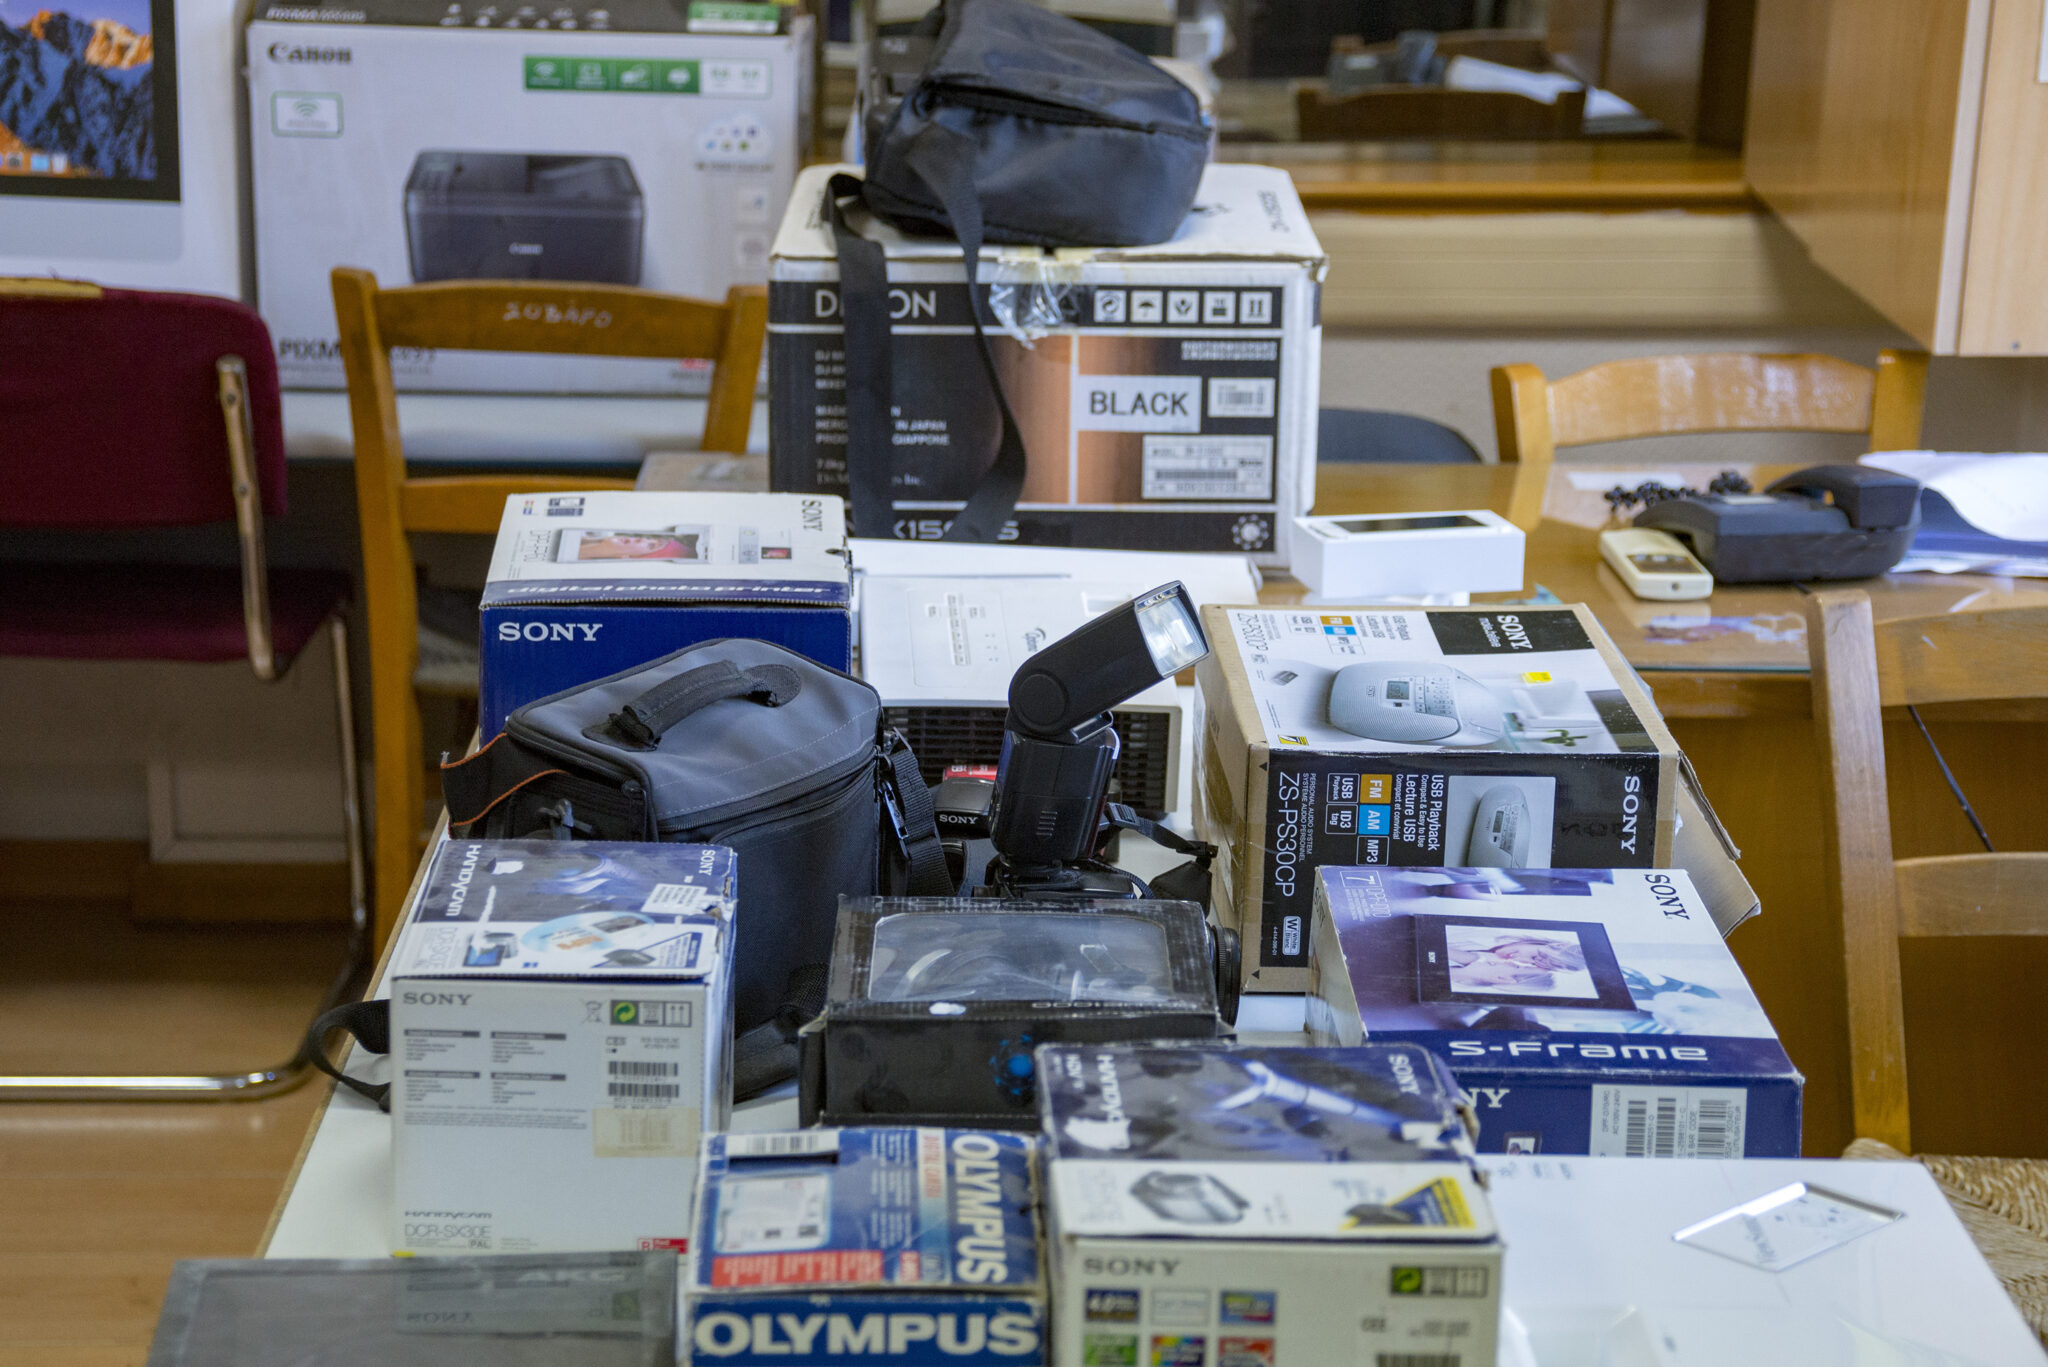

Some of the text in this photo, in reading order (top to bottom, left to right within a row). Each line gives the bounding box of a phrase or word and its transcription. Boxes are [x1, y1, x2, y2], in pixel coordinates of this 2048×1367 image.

[267, 41, 353, 64] Canon
[1089, 390, 1189, 417] BLACK
[801, 499, 823, 531] SONY
[507, 584, 831, 594] digital photo printer
[499, 622, 603, 642] SONY
[1497, 615, 1534, 650] SONY
[1333, 775, 1341, 801] Playback
[1342, 777, 1354, 799] USB
[1369, 779, 1383, 799] FM
[1393, 774, 1404, 803] Compact
[1419, 774, 1430, 803] Compact
[939, 813, 979, 825] SONY
[1300, 803, 1308, 824] AUDIO
[1306, 773, 1317, 855] PERSONAL AUDIO SYSTEM
[1329, 812, 1339, 826] tag
[1340, 810, 1352, 829] ID3
[1403, 774, 1419, 843] Lecture USB
[1417, 810, 1427, 827] Easy
[1427, 774, 1444, 851] USB Playback
[1621, 775, 1641, 855] SONY
[1367, 810, 1381, 830] AM
[1392, 811, 1401, 840] convivial
[1274, 771, 1301, 897] ZS-PS30CP
[1298, 824, 1307, 863] PERSONNEL
[1417, 835, 1425, 848] Use
[699, 849, 716, 876] SONY
[1366, 839, 1379, 864] MP3
[446, 844, 483, 917] HANDYCAM
[1644, 873, 1691, 921] SONY
[1285, 917, 1298, 931] W
[1283, 932, 1291, 950] Blanc
[1290, 932, 1299, 950] White
[402, 991, 473, 1007] SONY
[1449, 1040, 1709, 1062] S-Frame
[1387, 1053, 1420, 1096] SONY
[1688, 1110, 1697, 1131] CODE
[404, 1210, 493, 1219] HANDYCAM
[952, 1134, 1009, 1284] OLYMPUS
[404, 1223, 492, 1238] DCR-SX30E
[468, 1239, 491, 1248] PAL
[1083, 1257, 1180, 1277] SONY
[693, 1311, 1040, 1357] OLYMPUS
